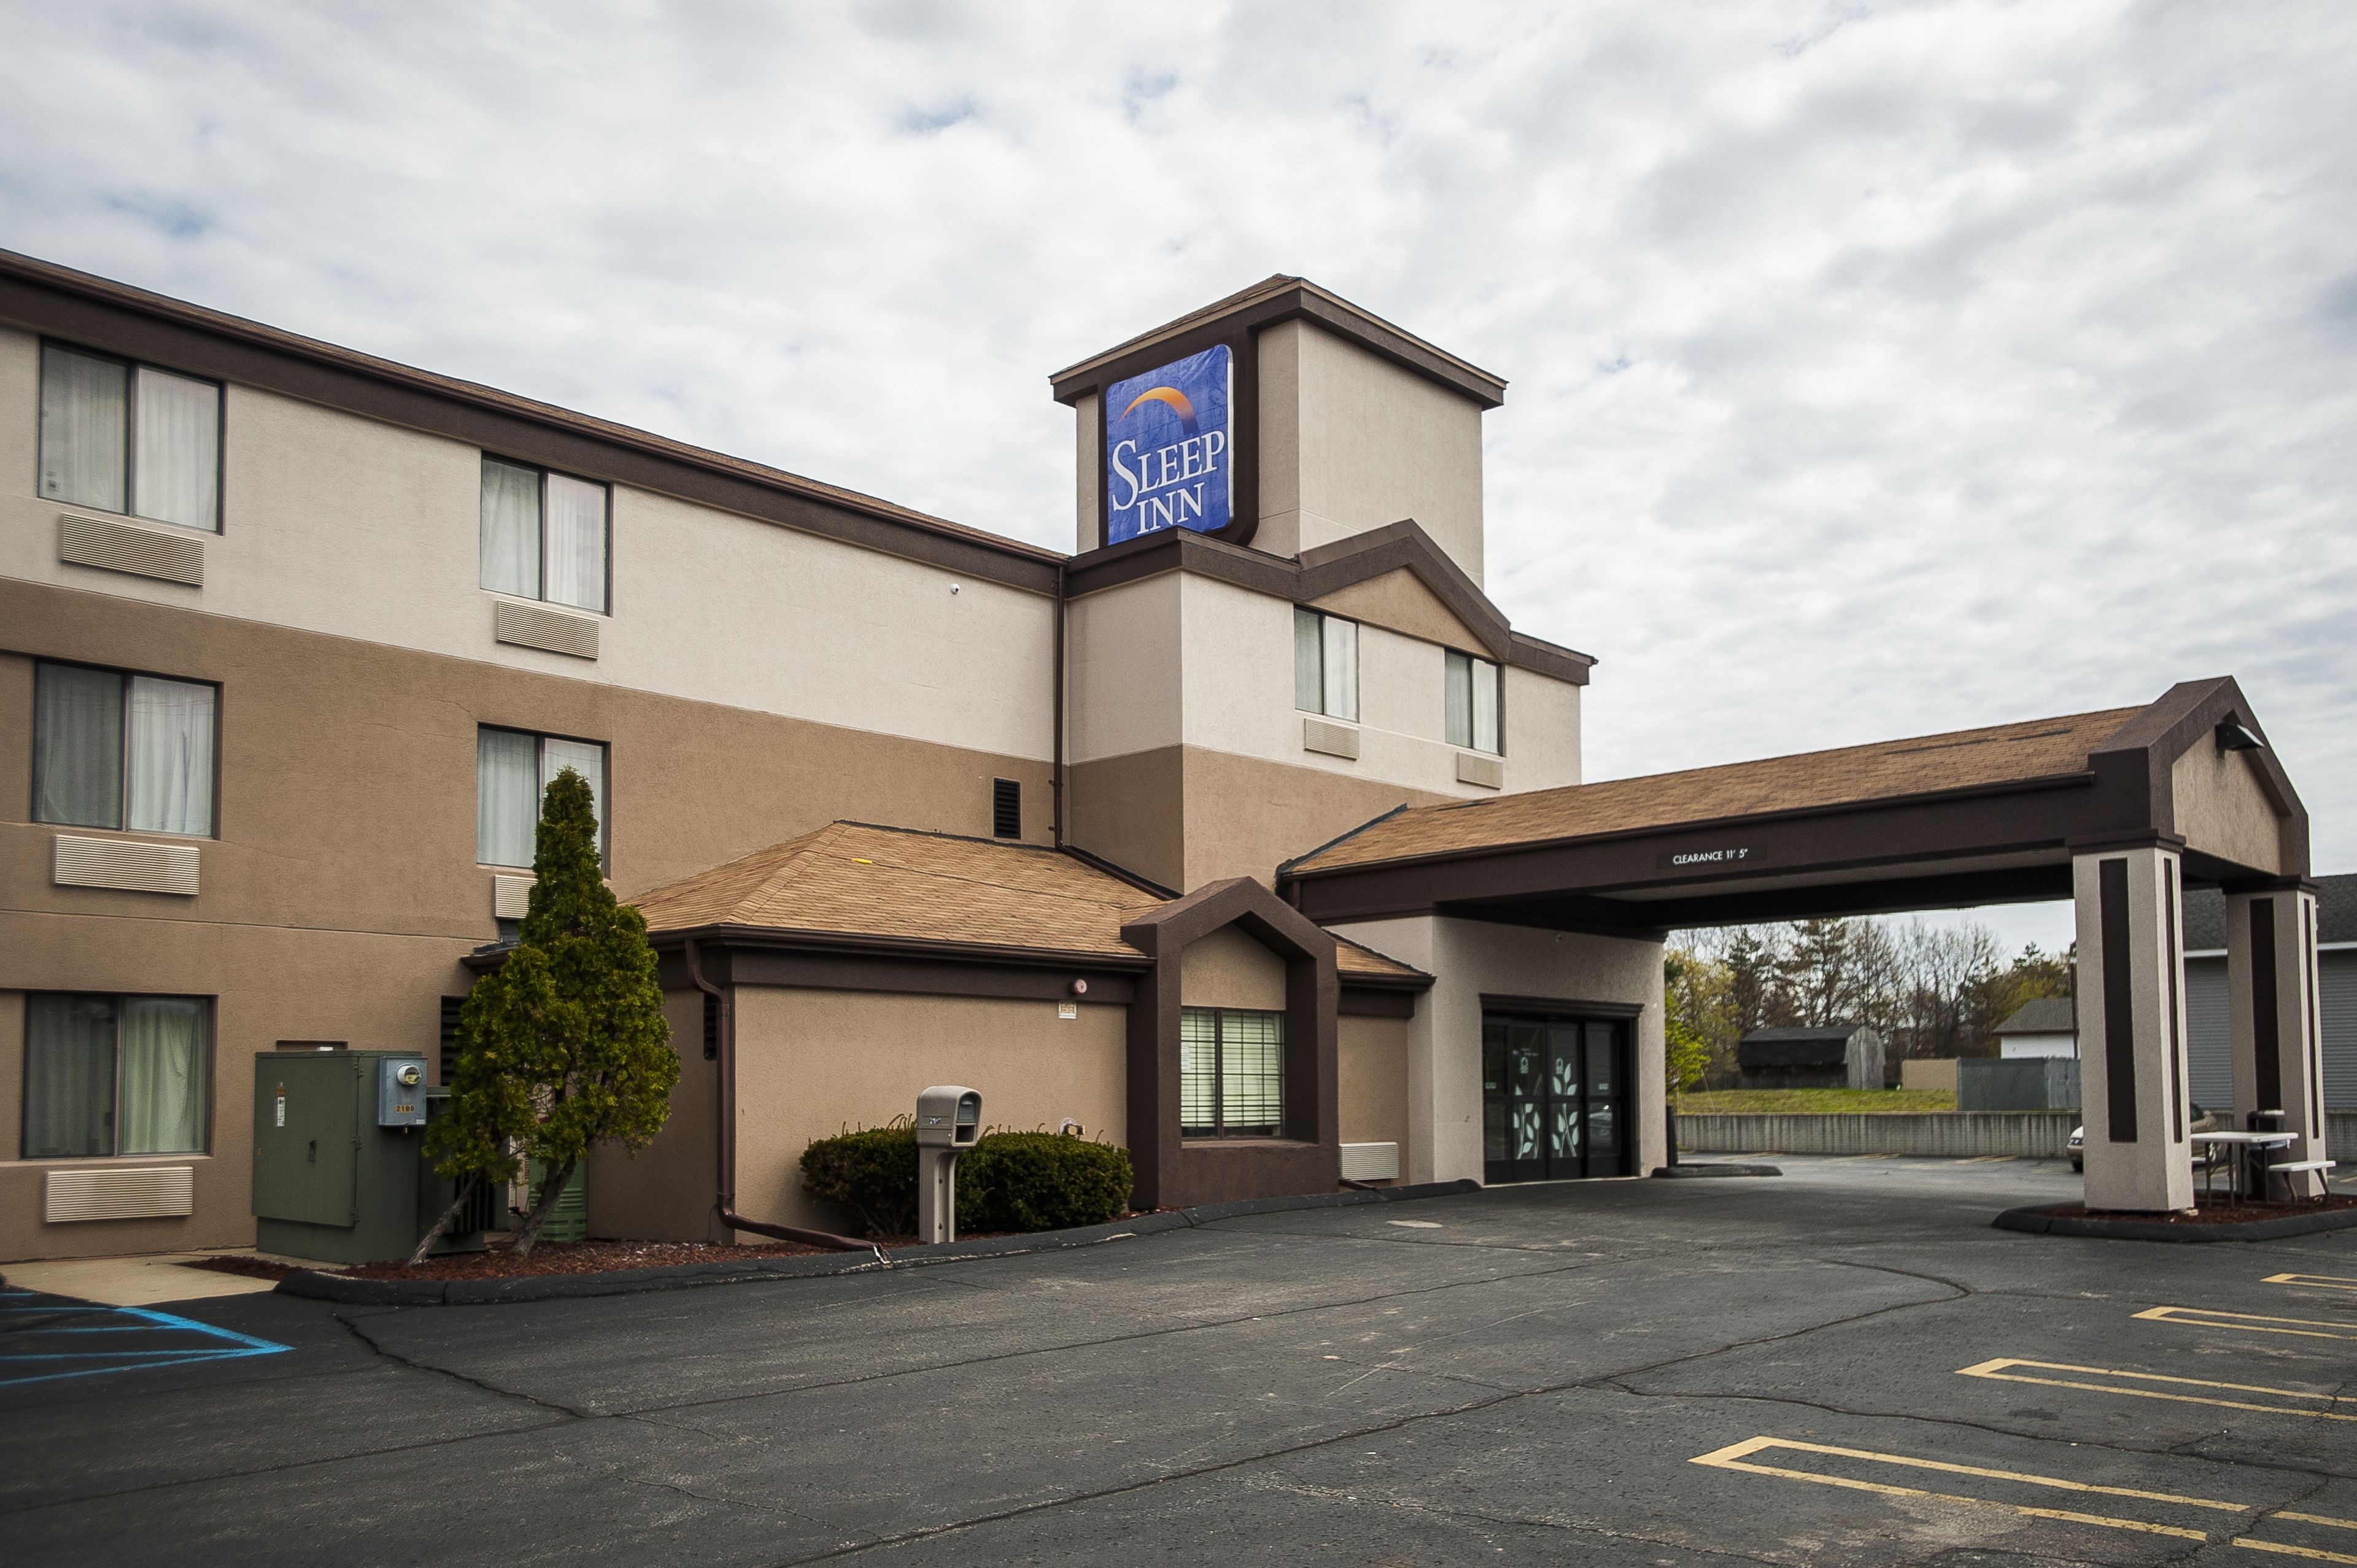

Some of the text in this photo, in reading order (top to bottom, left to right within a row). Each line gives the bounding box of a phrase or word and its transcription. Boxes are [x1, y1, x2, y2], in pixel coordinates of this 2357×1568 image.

[1112, 430, 1225, 511] SLEEP
[1136, 482, 1205, 535] INN
[1673, 851, 1723, 865] CLEARANCE
